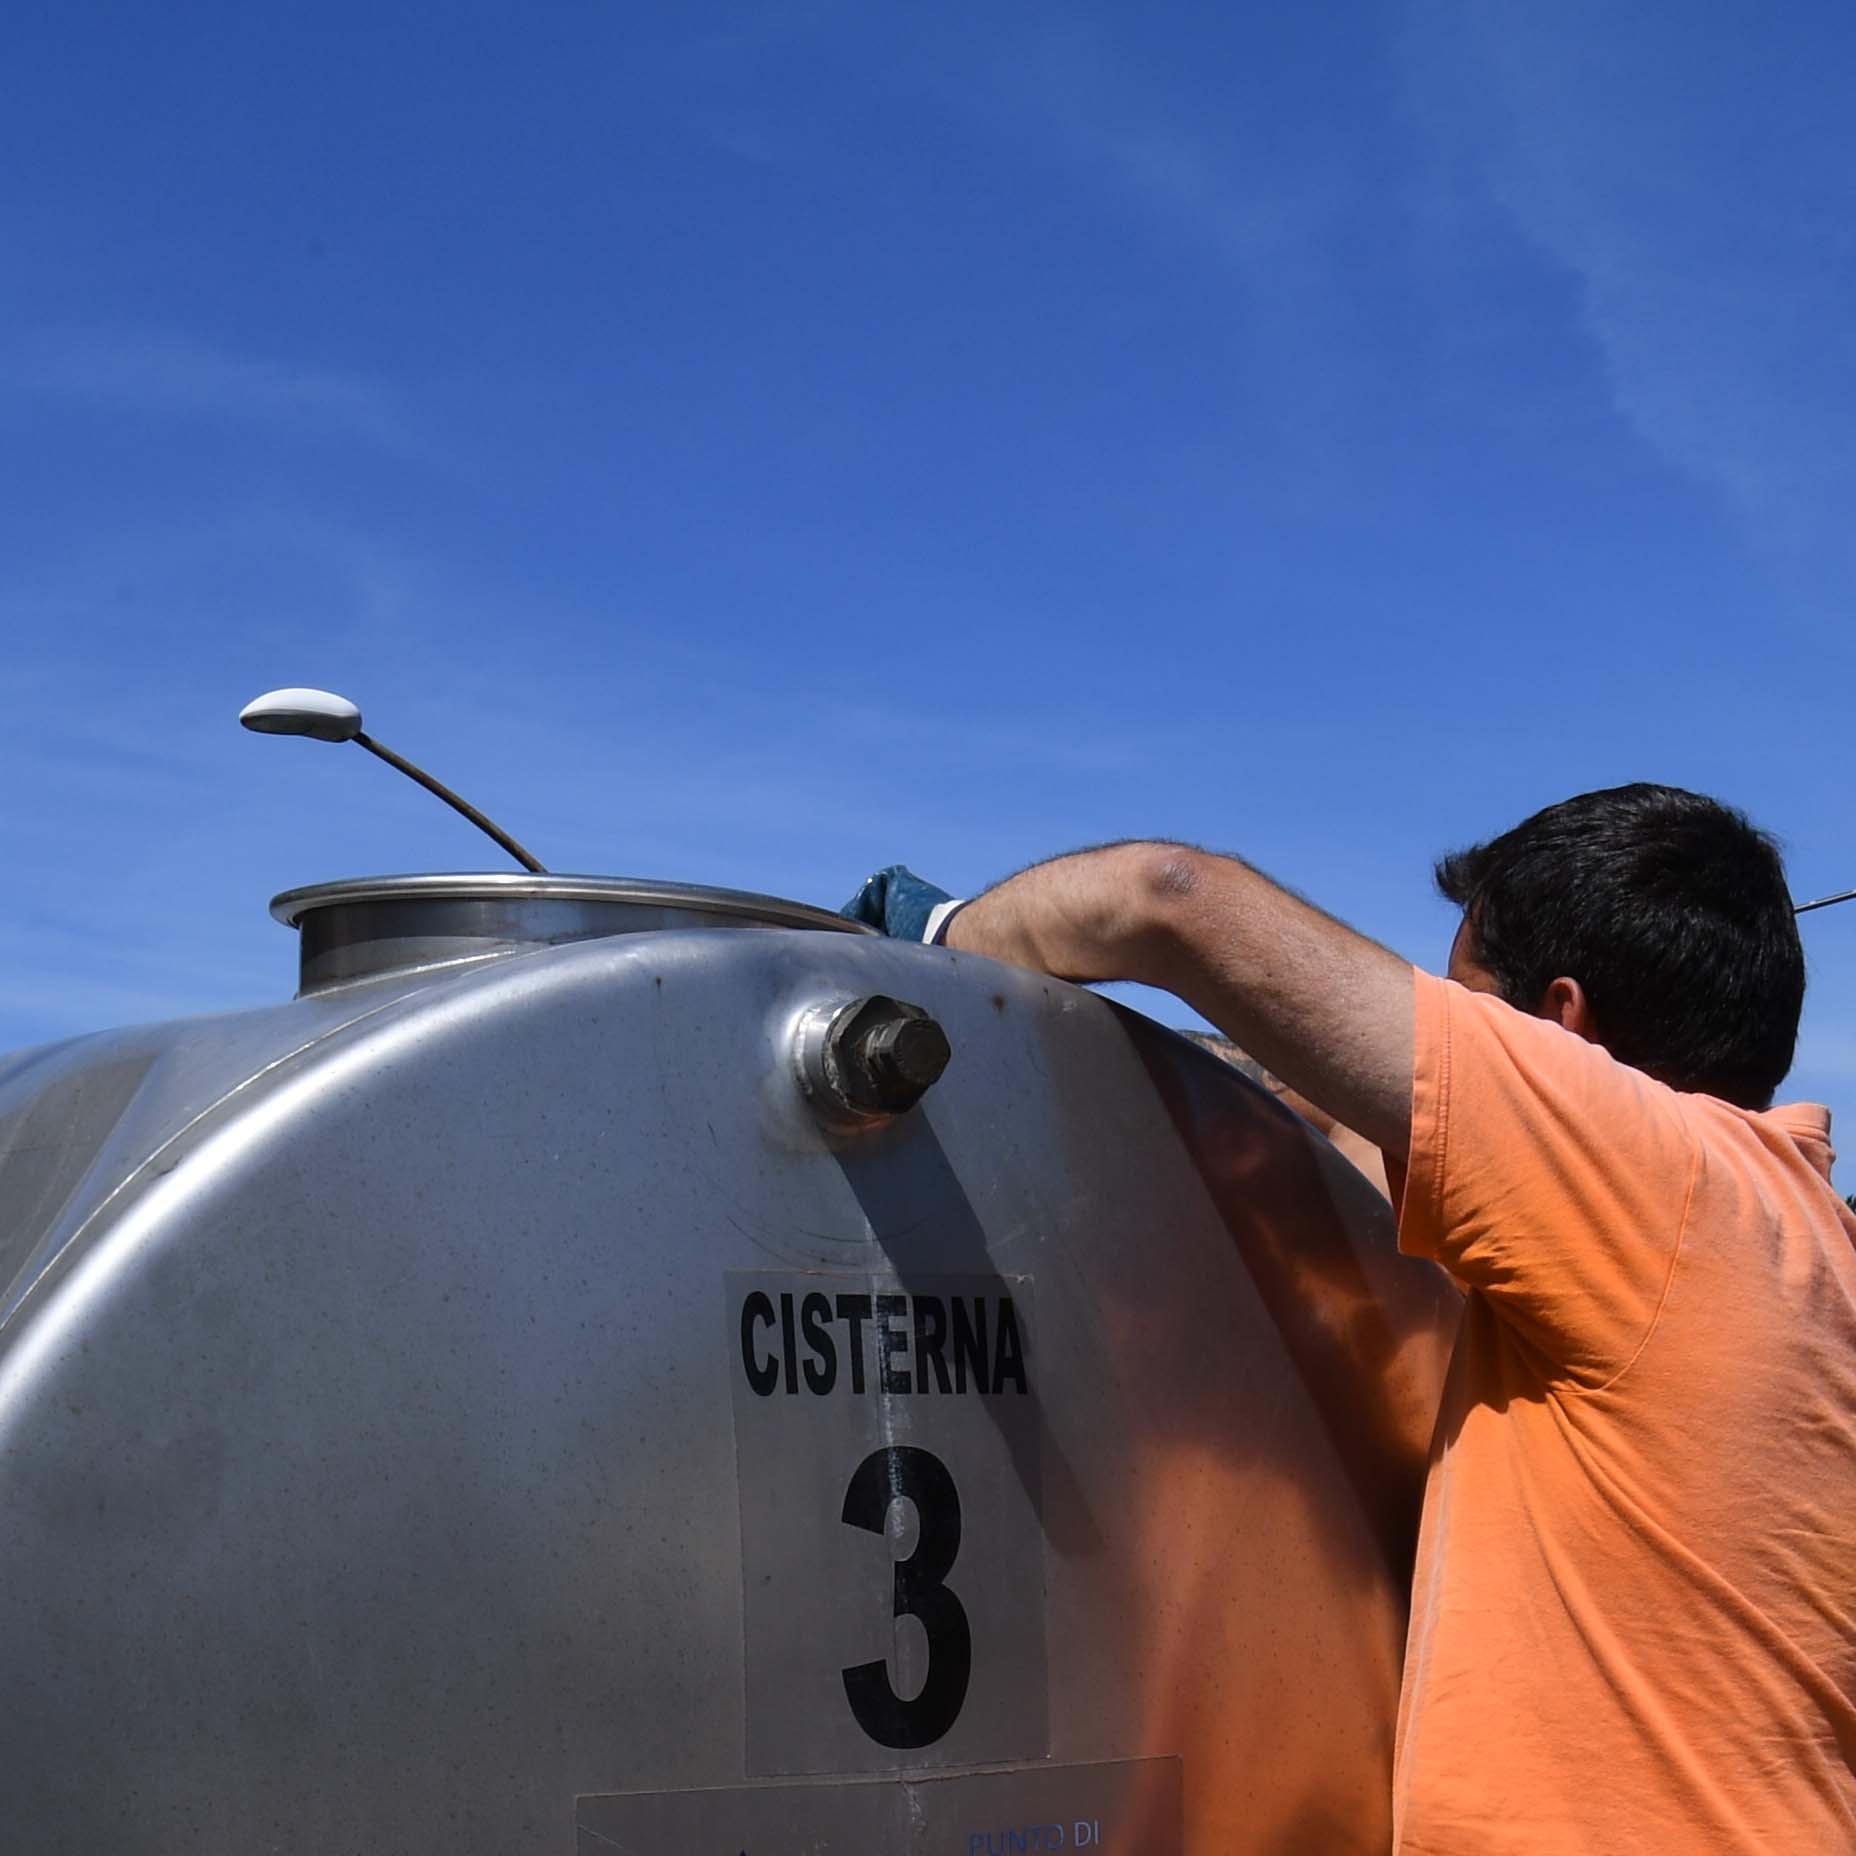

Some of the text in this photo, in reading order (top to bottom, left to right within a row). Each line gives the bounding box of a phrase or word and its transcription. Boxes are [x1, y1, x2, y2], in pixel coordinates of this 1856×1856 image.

[740, 1291, 1028, 1397] CISTERNA
[841, 1445, 972, 1749] 3
[1073, 1819, 1101, 1848] DI
